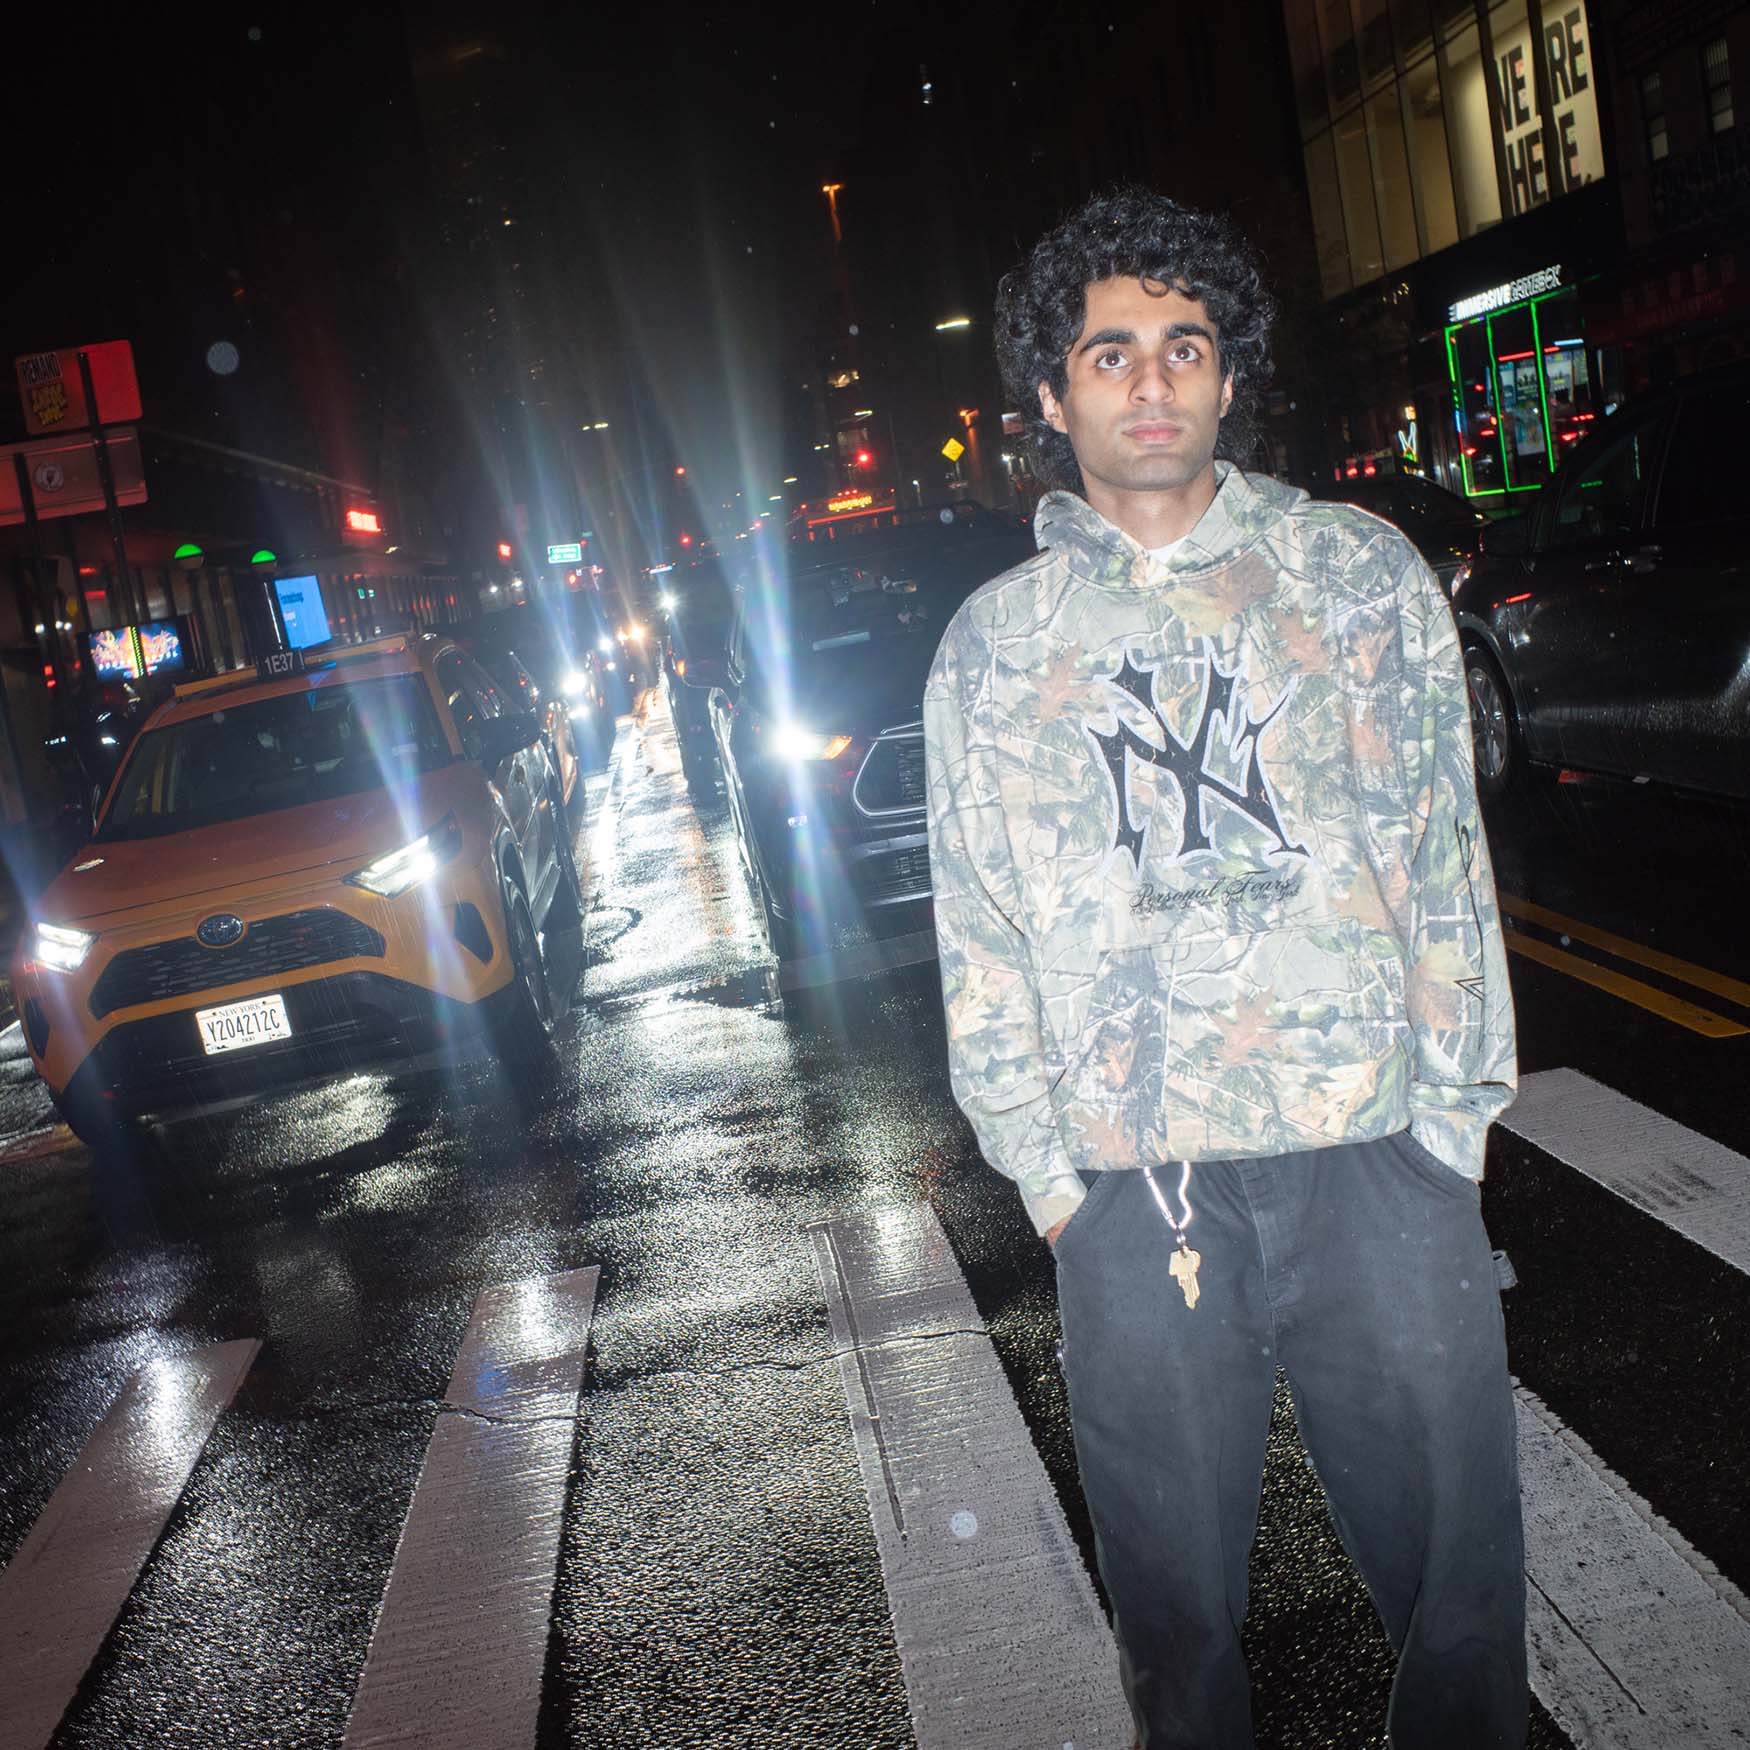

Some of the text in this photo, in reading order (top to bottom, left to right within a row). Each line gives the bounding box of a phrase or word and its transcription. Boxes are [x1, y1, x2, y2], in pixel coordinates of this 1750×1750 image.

[1537, 6, 1589, 112] RE
[264, 652, 294, 675] 1E37
[1129, 876, 1226, 908] Personal
[206, 1008, 280, 1042] Y204212C
[218, 1002, 262, 1018] NEW YORK
